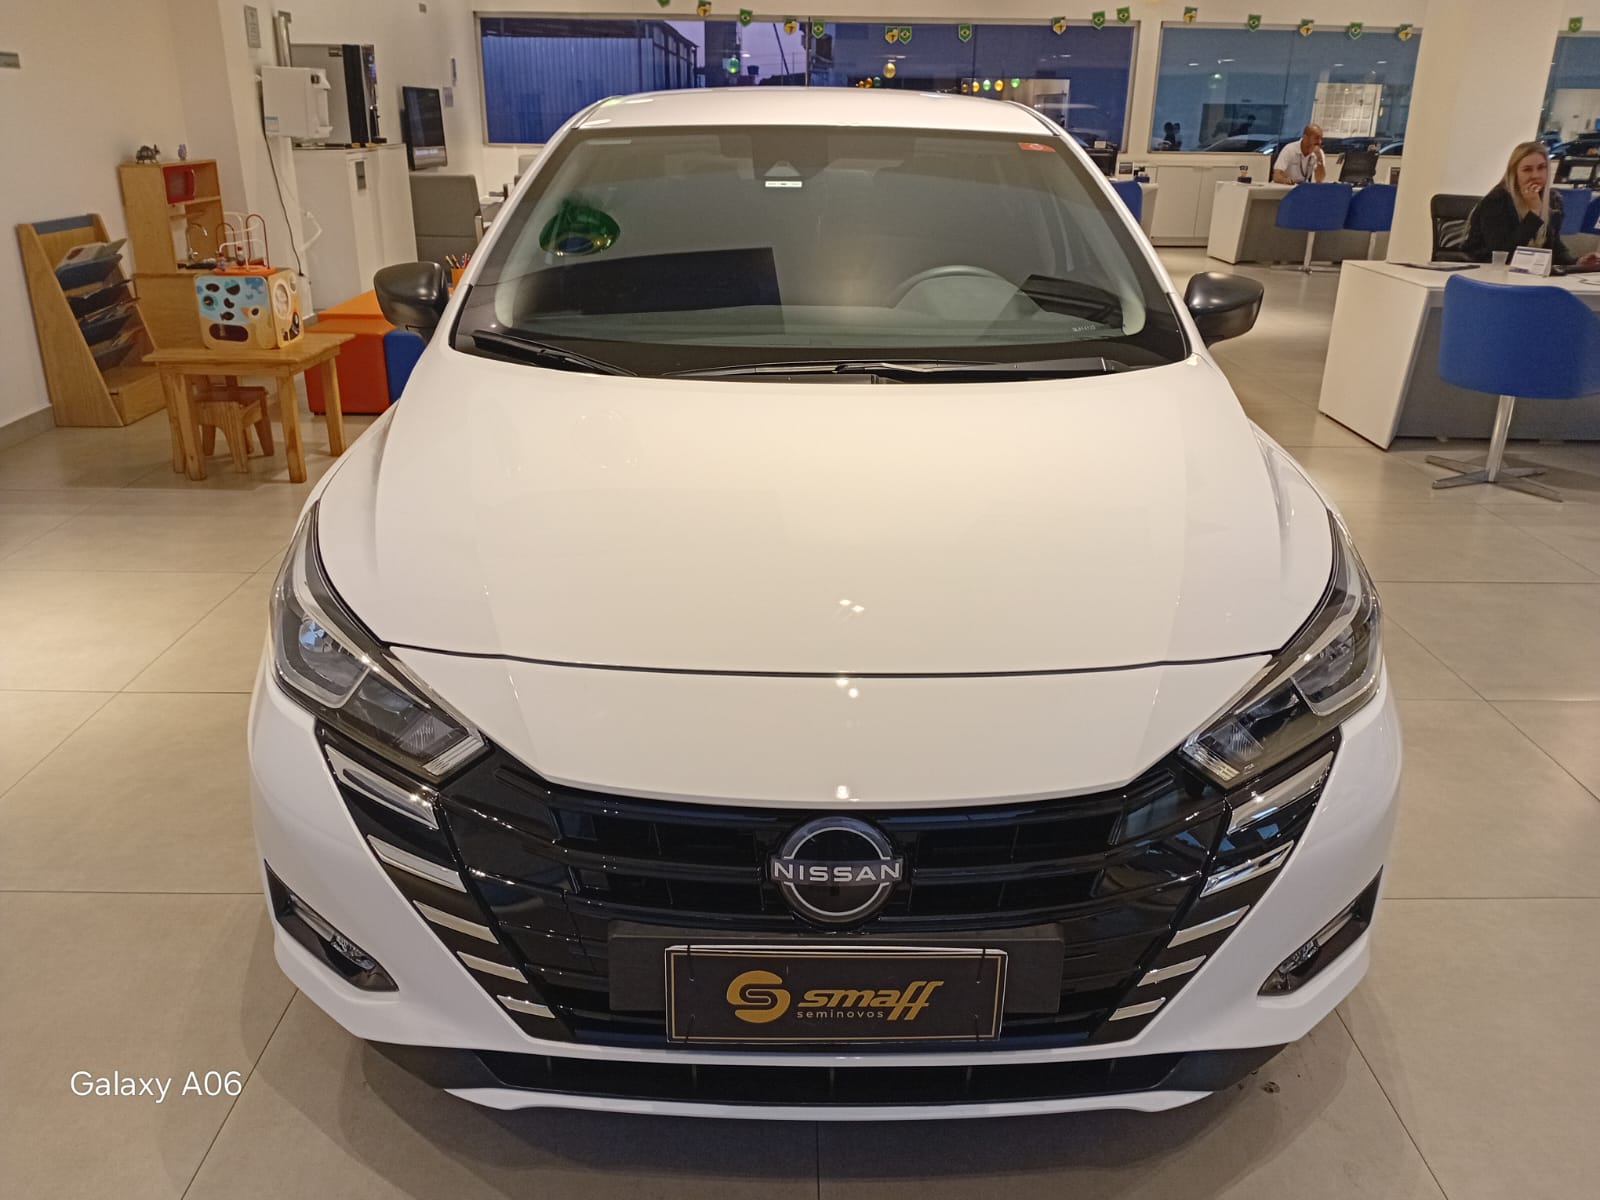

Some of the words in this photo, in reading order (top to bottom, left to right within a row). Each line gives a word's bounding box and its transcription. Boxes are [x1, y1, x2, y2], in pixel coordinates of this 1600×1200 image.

[773, 861, 902, 882] NISSAN
[797, 980, 944, 1021] smaff
[796, 1007, 885, 1019] seminovos
